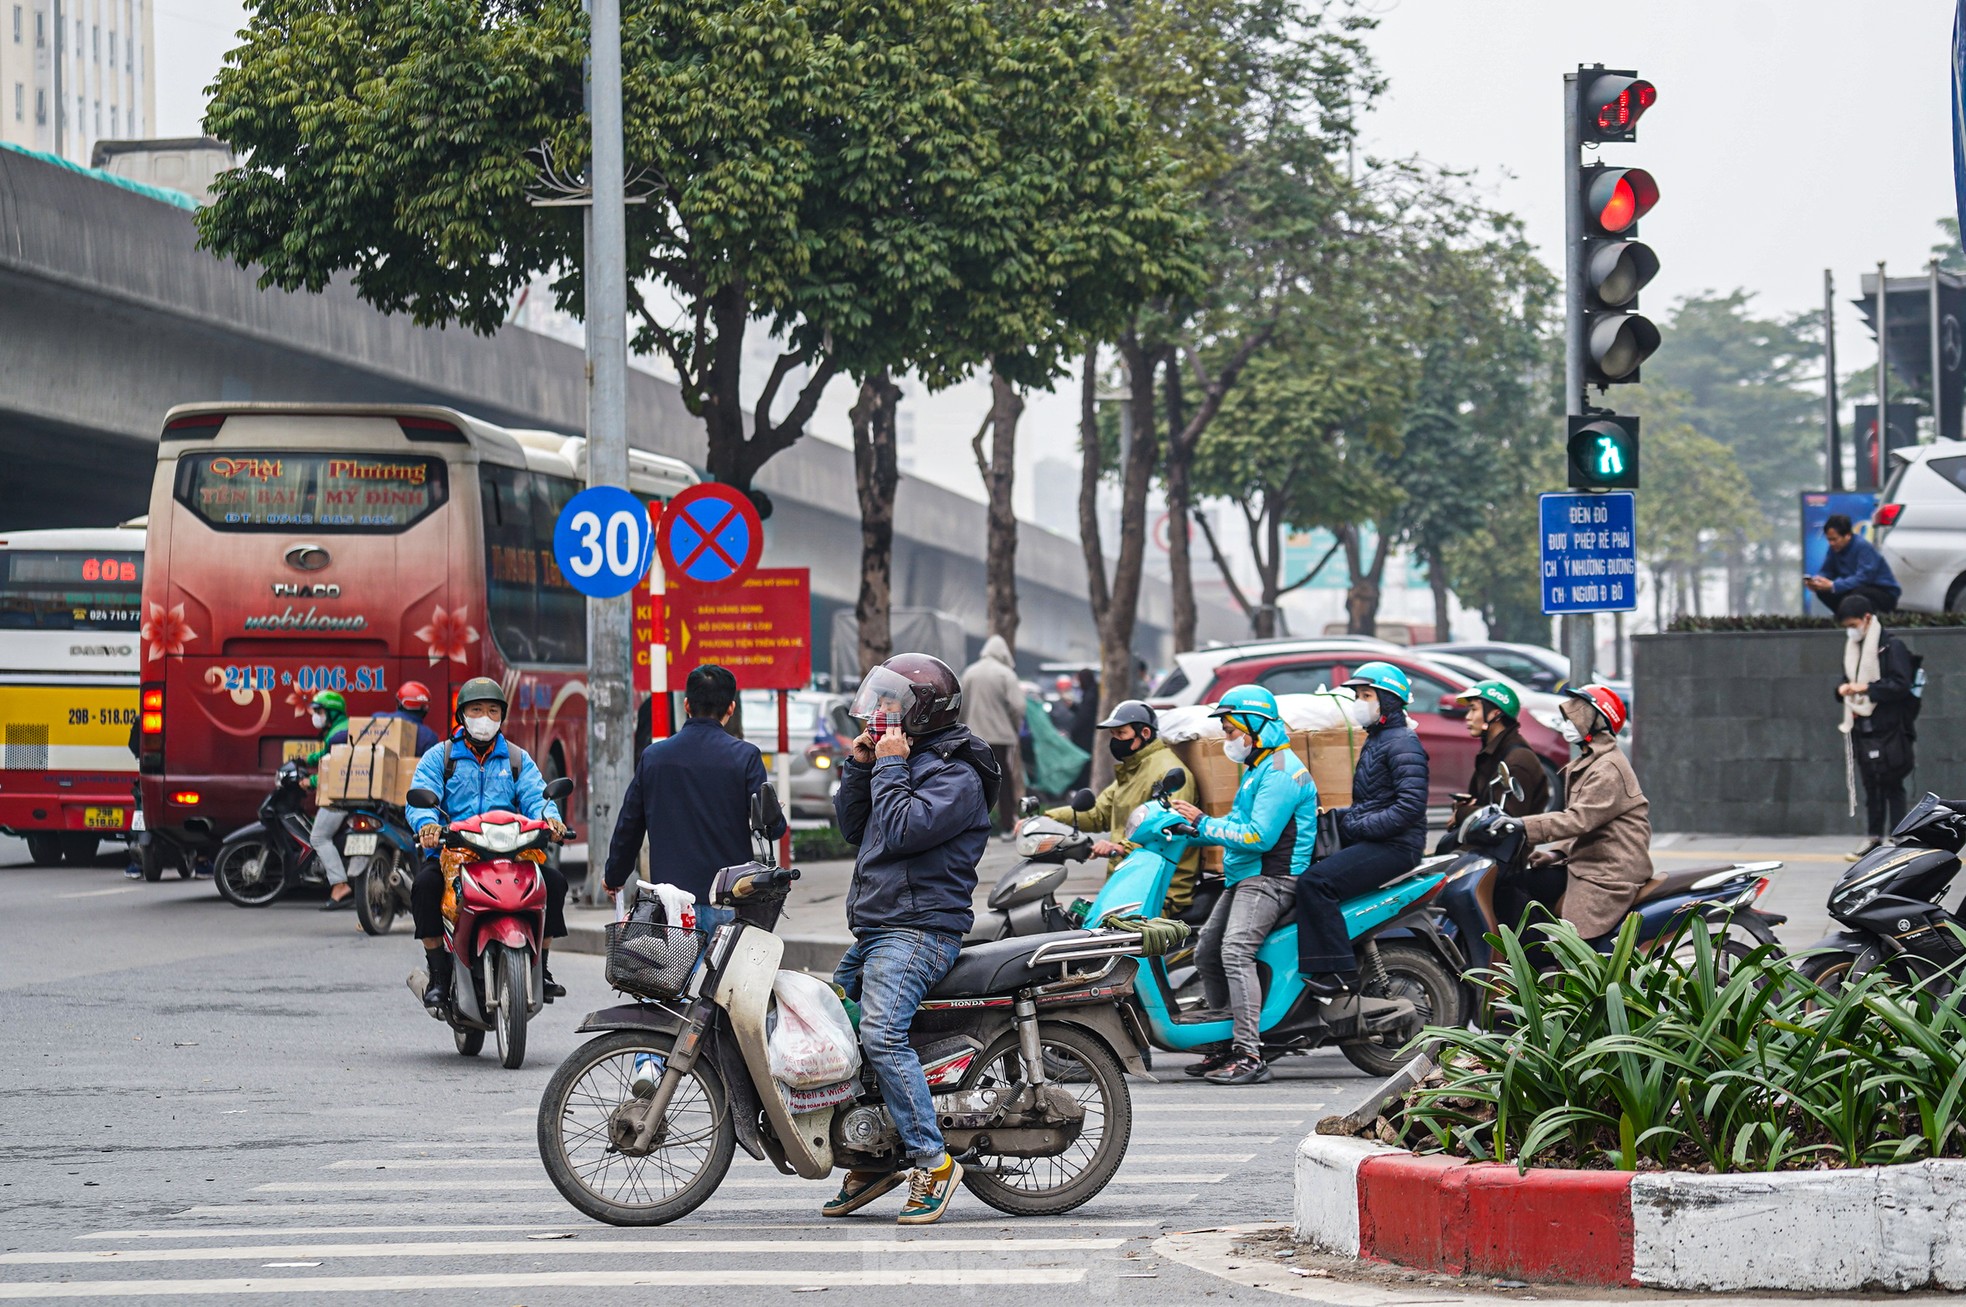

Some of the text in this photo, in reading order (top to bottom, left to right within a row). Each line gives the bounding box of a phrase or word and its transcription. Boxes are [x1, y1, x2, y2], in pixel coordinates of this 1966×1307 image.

[210, 457, 427, 485] Việt Phương
[200, 485, 248, 504] YÊN
[325, 484, 361, 505] MỸ
[365, 486, 424, 506] ĐÌNH
[1569, 501, 1608, 524] ĐÈN ĐỎ
[569, 510, 640, 577] 30
[1574, 528, 1597, 550] PHÉP
[1598, 528, 1611, 549] RẼ
[1612, 526, 1631, 548] PHẢI
[82, 558, 137, 581] 60B
[1607, 553, 1635, 576] ĐƯỜNG
[271, 583, 341, 599] THACO
[89, 609, 108, 621] 024
[244, 605, 369, 632] mobihome
[225, 664, 388, 692] 21B 006.81
[1487, 687, 1511, 705] Grab
[68, 708, 89, 725] 29B
[595, 804, 610, 818] C7
[950, 999, 985, 1007] HONDA
